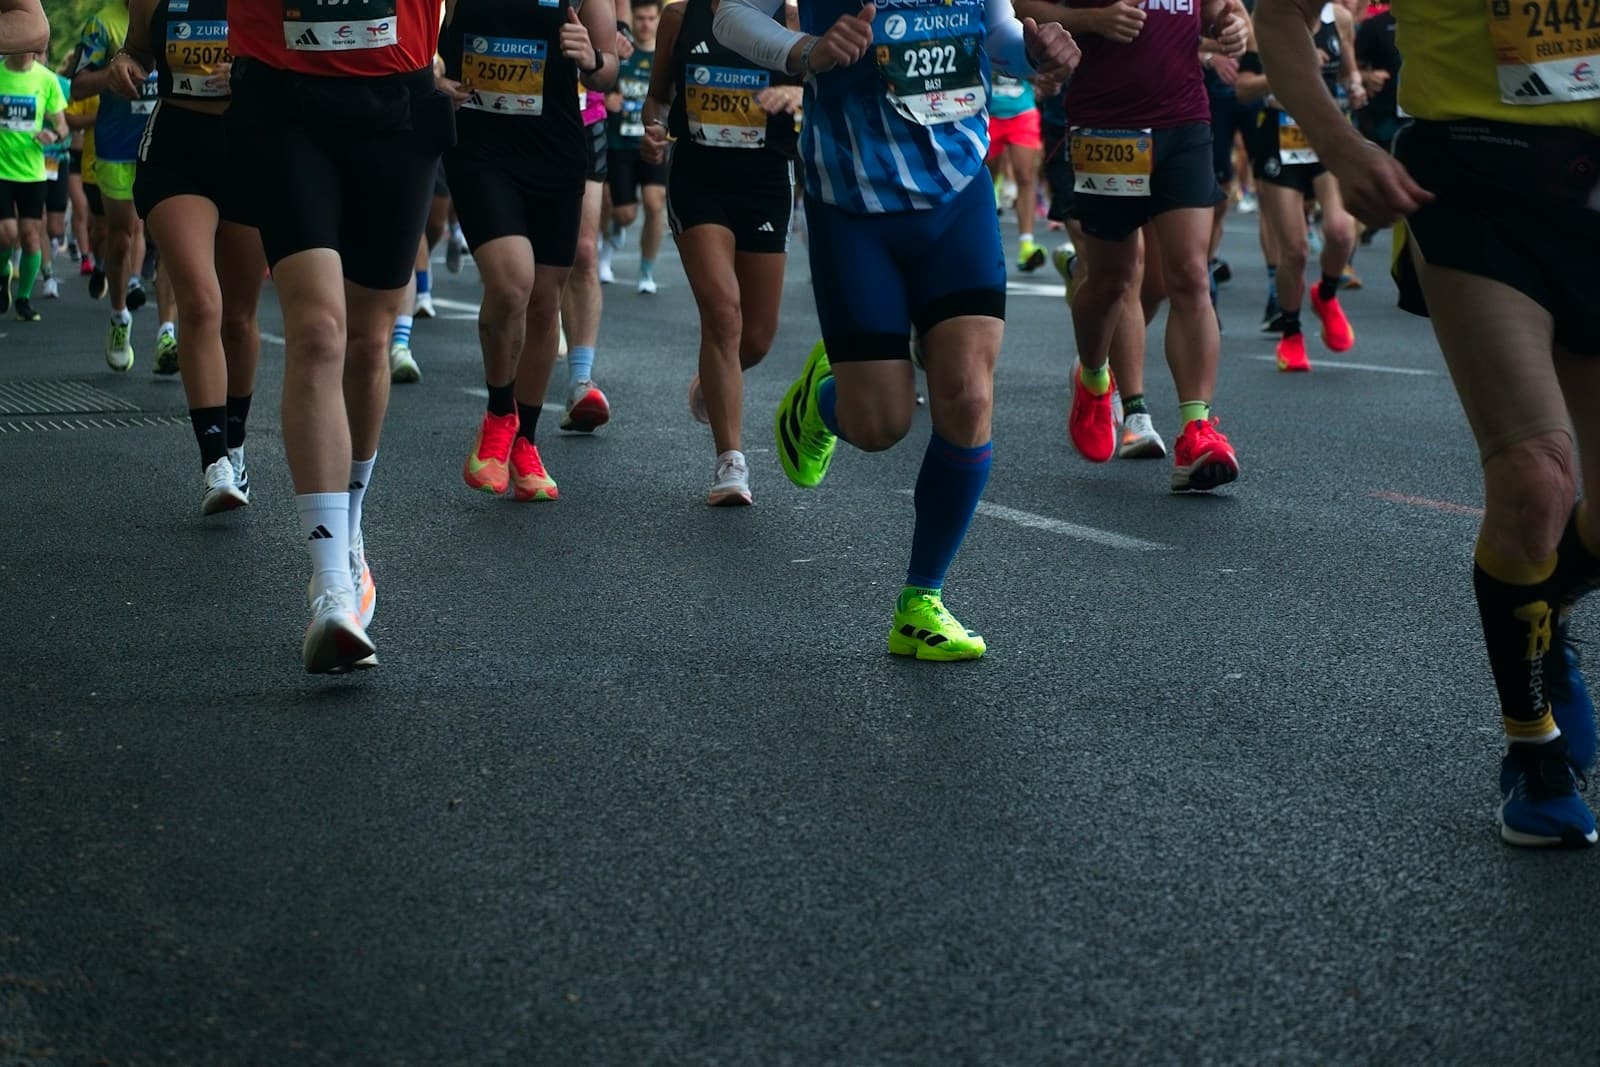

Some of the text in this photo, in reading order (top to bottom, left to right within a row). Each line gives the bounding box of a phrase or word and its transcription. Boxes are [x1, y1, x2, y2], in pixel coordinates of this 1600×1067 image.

[914, 13, 969, 32] ZURICH
[182, 47, 233, 65] 25078
[493, 42, 537, 54] ZURICH
[904, 45, 957, 77] 2322
[478, 62, 528, 81] 25077
[715, 72, 760, 85] ZURICH
[925, 78, 942, 91] BASI
[701, 93, 750, 113] 25079
[1085, 143, 1134, 162] 25203
